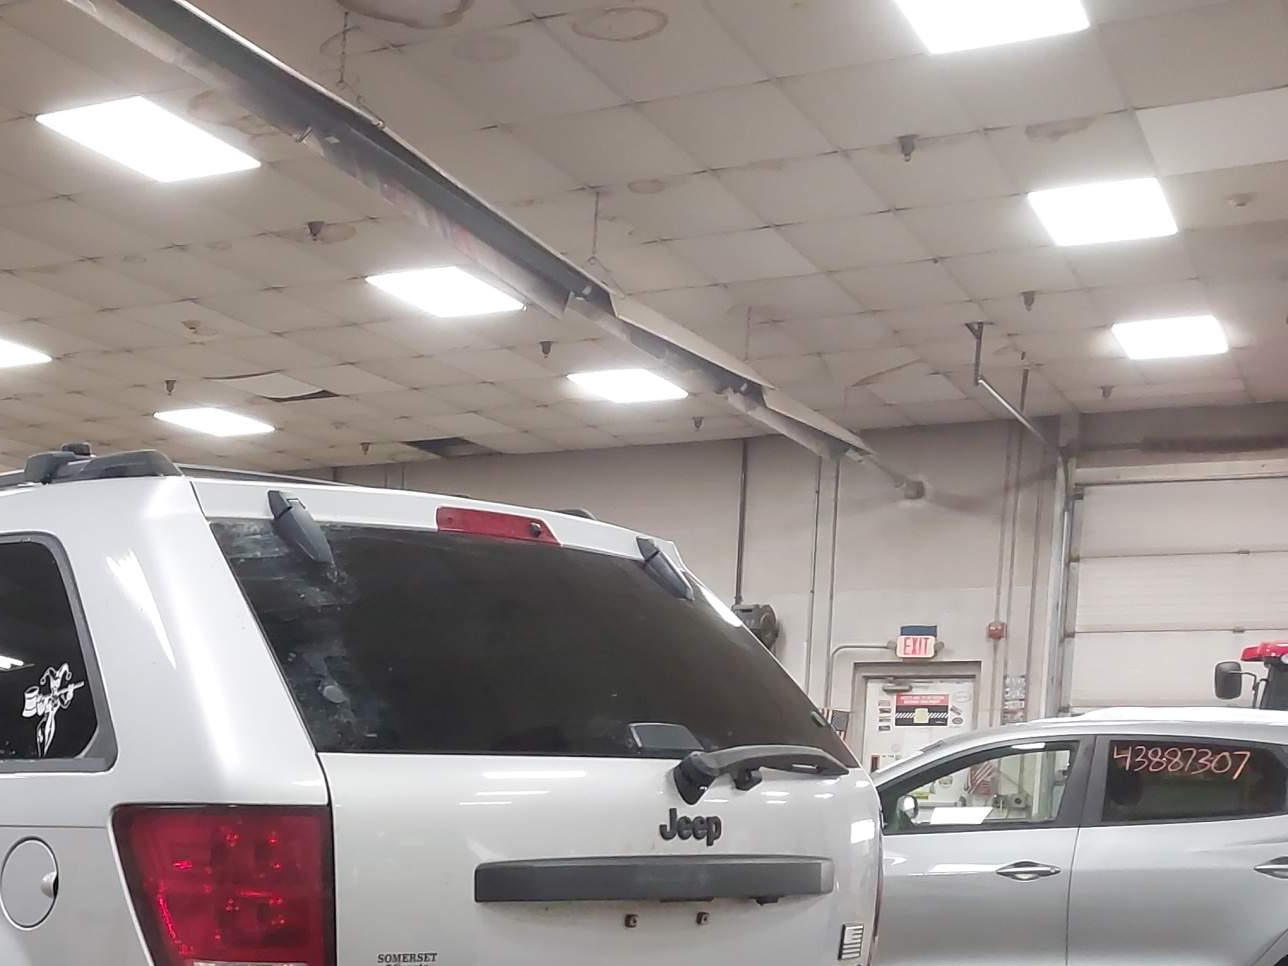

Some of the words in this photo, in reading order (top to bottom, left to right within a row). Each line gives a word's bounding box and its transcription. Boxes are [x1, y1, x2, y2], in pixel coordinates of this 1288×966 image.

[903, 636, 930, 656] EXIT
[1113, 744, 1252, 781] 43887307
[658, 811, 722, 847] Jeep
[377, 952, 438, 964] SOMERSET
